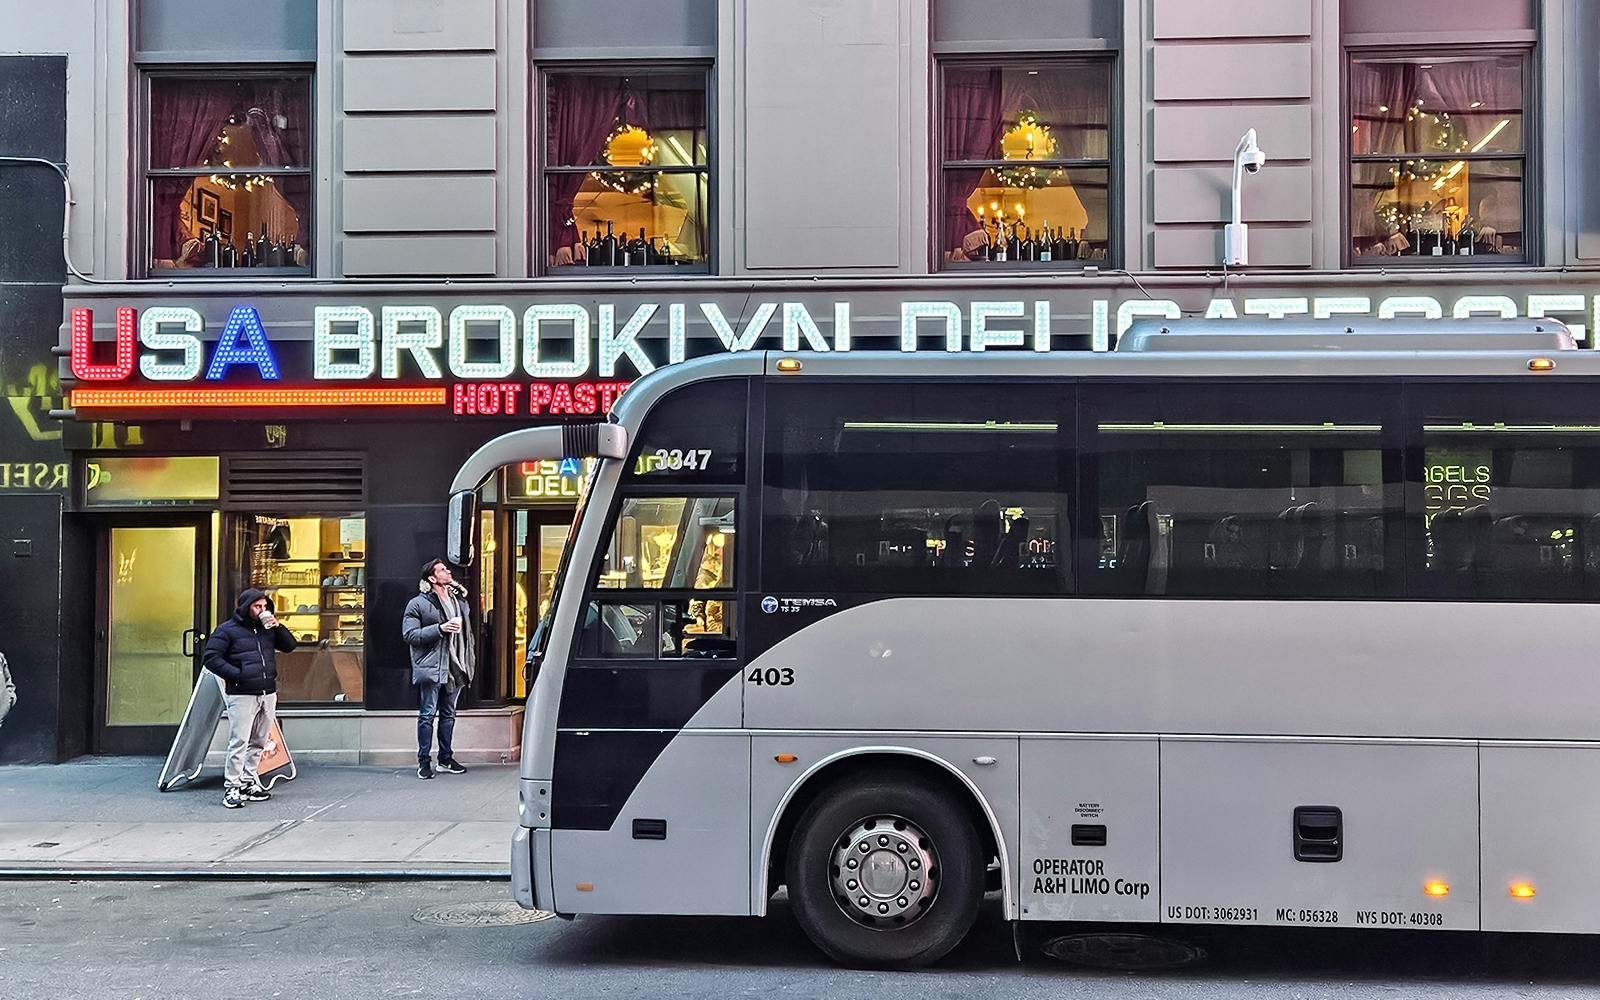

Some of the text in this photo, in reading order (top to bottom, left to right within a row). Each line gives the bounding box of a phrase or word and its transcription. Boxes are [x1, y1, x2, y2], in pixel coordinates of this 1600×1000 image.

[71, 305, 281, 382] USA
[453, 382, 522, 415] HOT
[655, 448, 712, 470] 3347
[525, 475, 589, 496] DELI
[780, 598, 837, 607] TEMSA
[747, 667, 795, 686] 403
[1033, 858, 1105, 876] OPERATOR
[1033, 877, 1150, 900] A&H LIMO Corp
[1168, 906, 1258, 921] US DOT: 3062931
[1276, 908, 1339, 923] MC: 056328
[1356, 911, 1443, 926] NYS DOT: 40308
